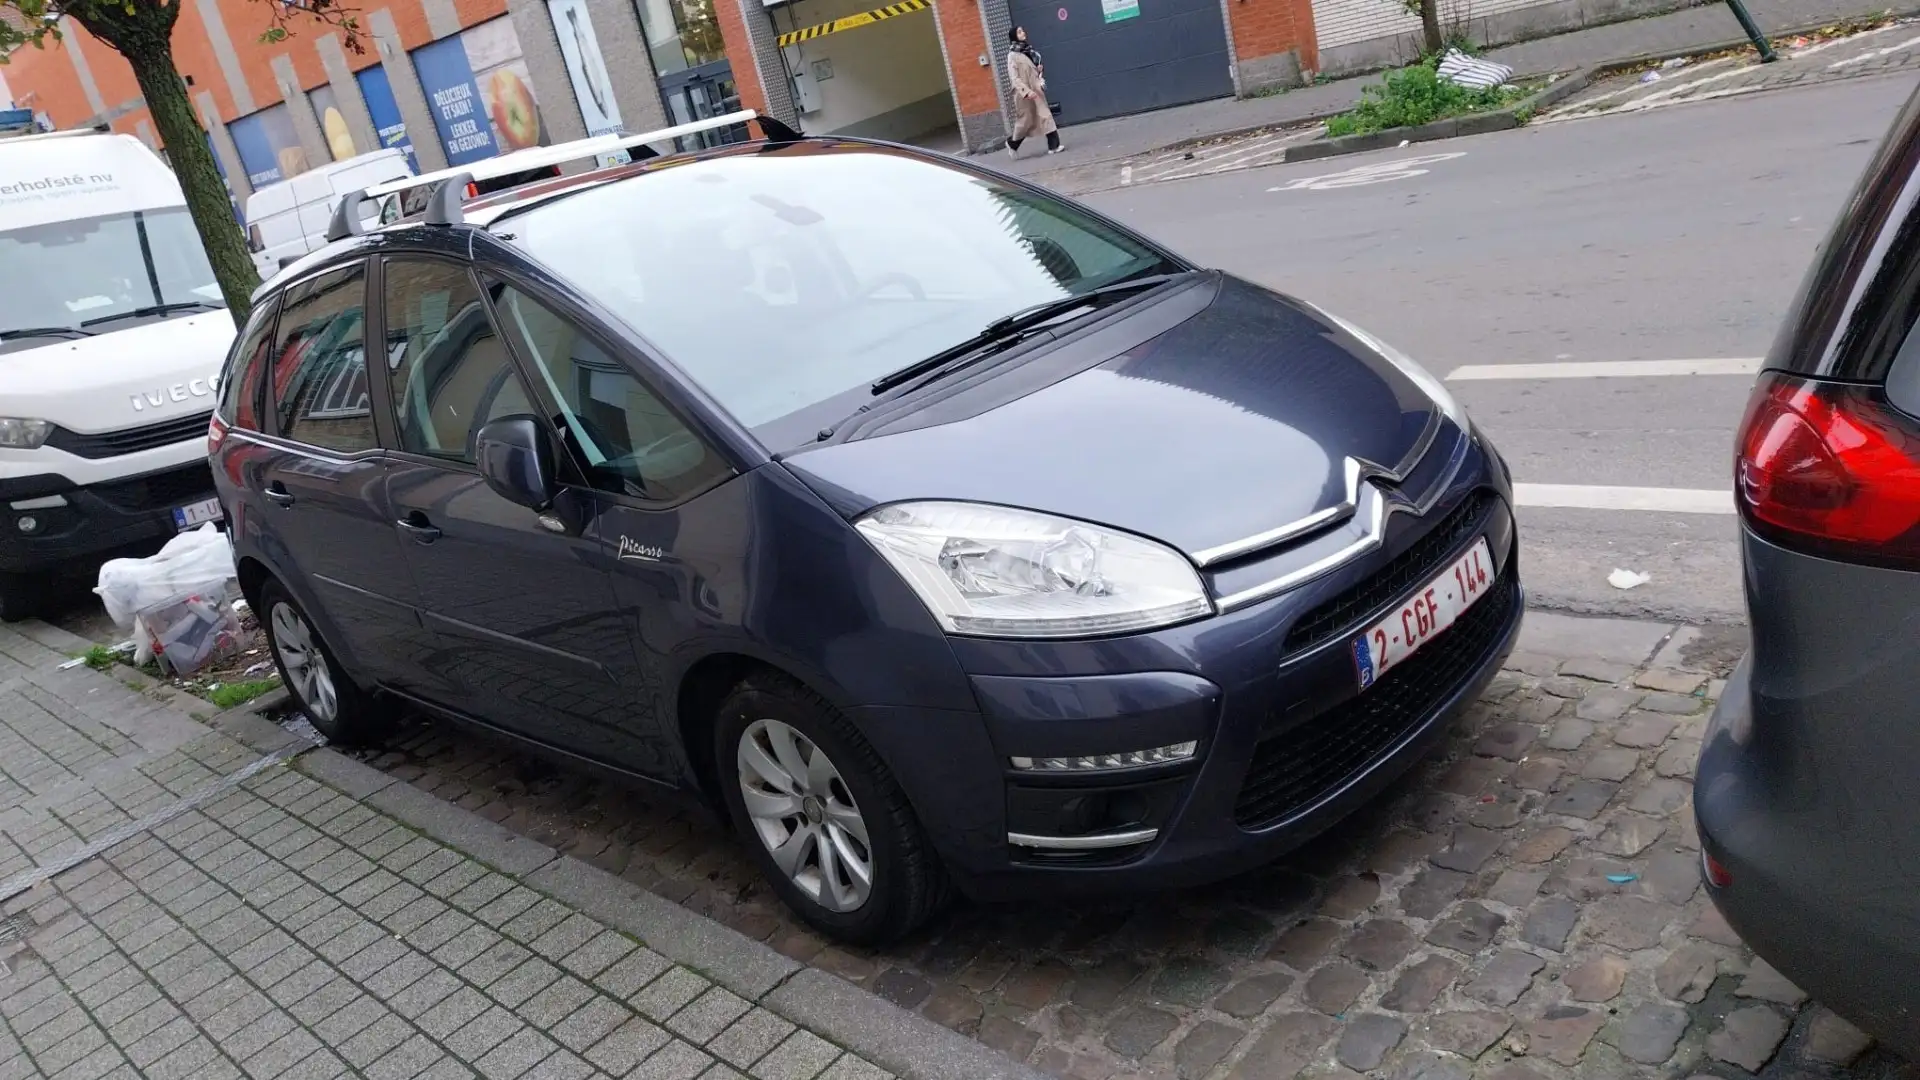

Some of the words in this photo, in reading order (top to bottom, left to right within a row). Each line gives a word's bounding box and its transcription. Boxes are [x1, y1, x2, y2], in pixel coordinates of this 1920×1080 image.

[433, 83, 472, 107] DÉLICIEUX
[441, 104, 452, 120] ET
[450, 119, 478, 138] LEKKER
[448, 139, 460, 154] EN
[458, 131, 491, 152] GEZOND!
[90, 173, 113, 184] nv
[188, 499, 222, 520] 1-U
[618, 535, 662, 560] Picasso
